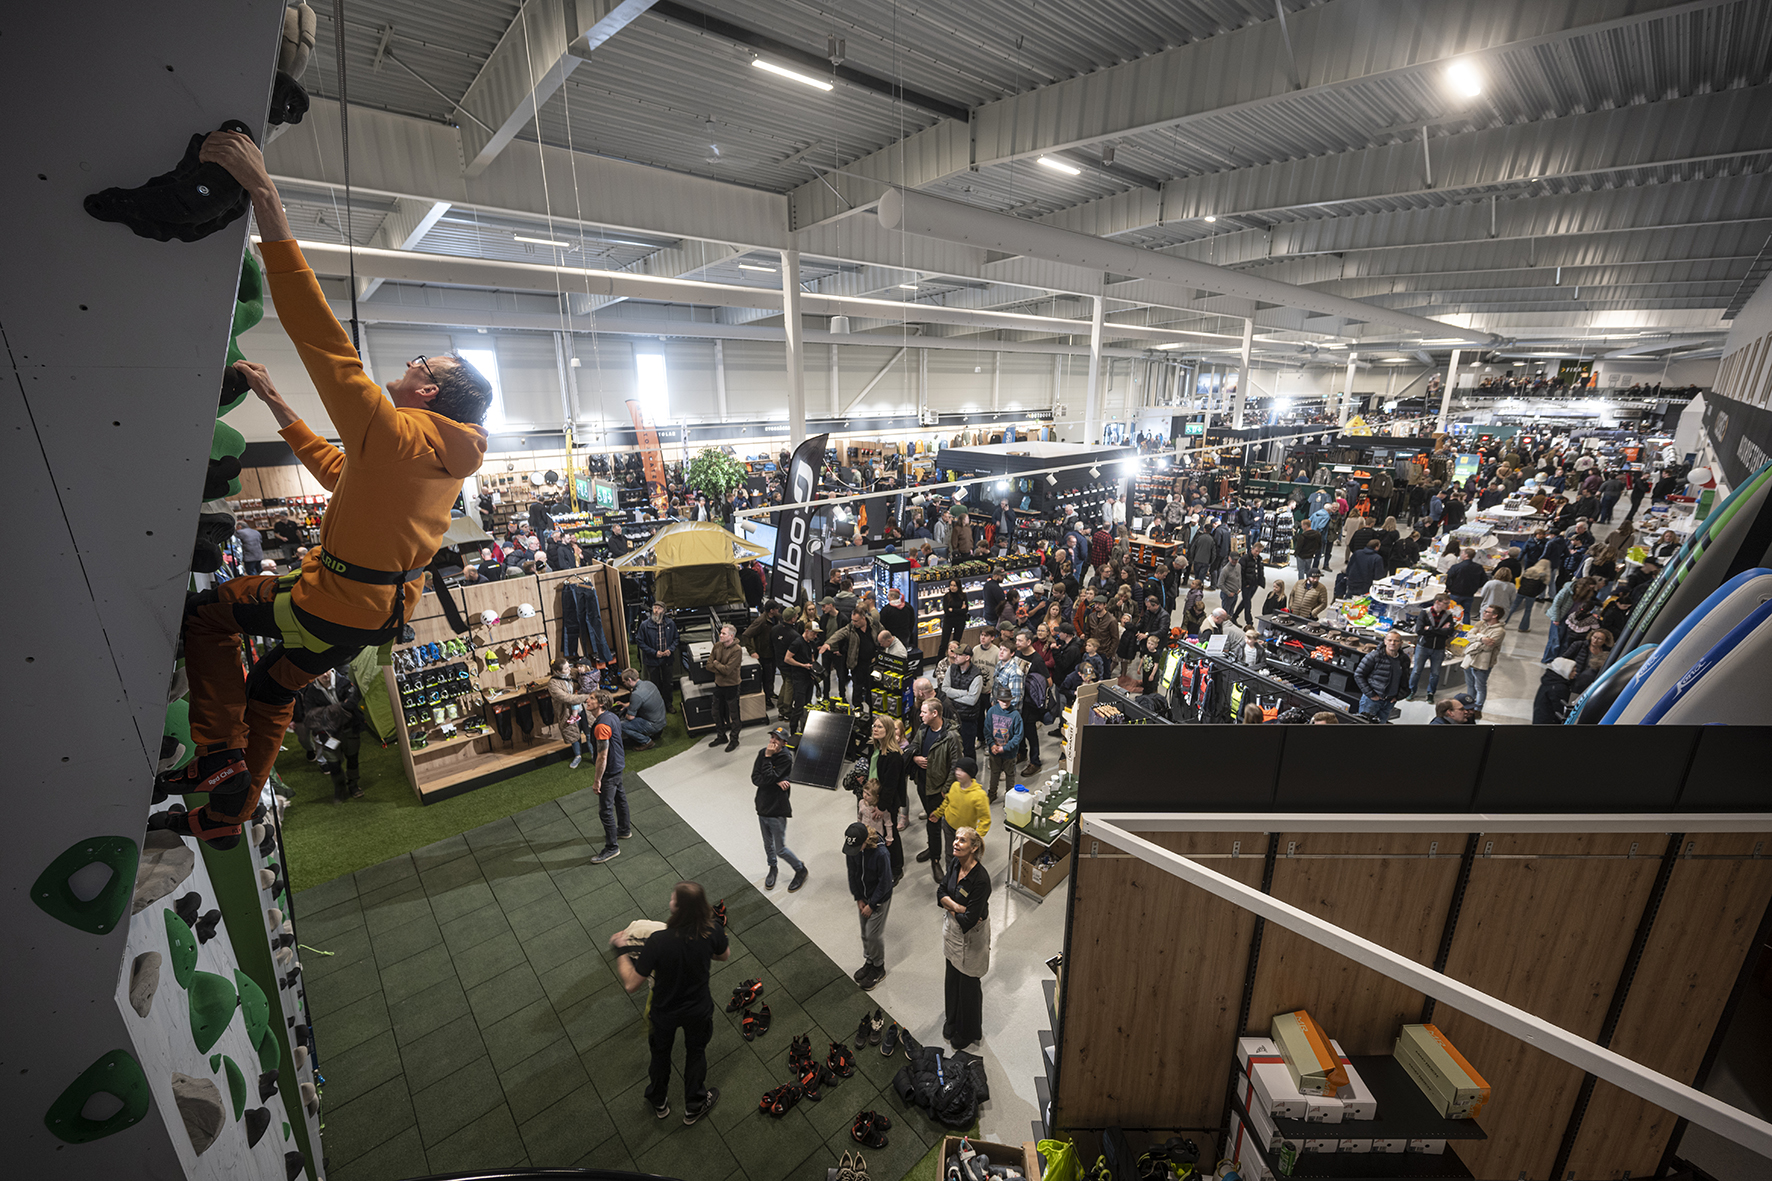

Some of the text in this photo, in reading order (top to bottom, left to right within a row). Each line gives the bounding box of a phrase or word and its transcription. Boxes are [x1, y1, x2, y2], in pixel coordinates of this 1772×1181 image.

[321, 548, 347, 573] LRID
[208, 767, 234, 786] Red Chili
